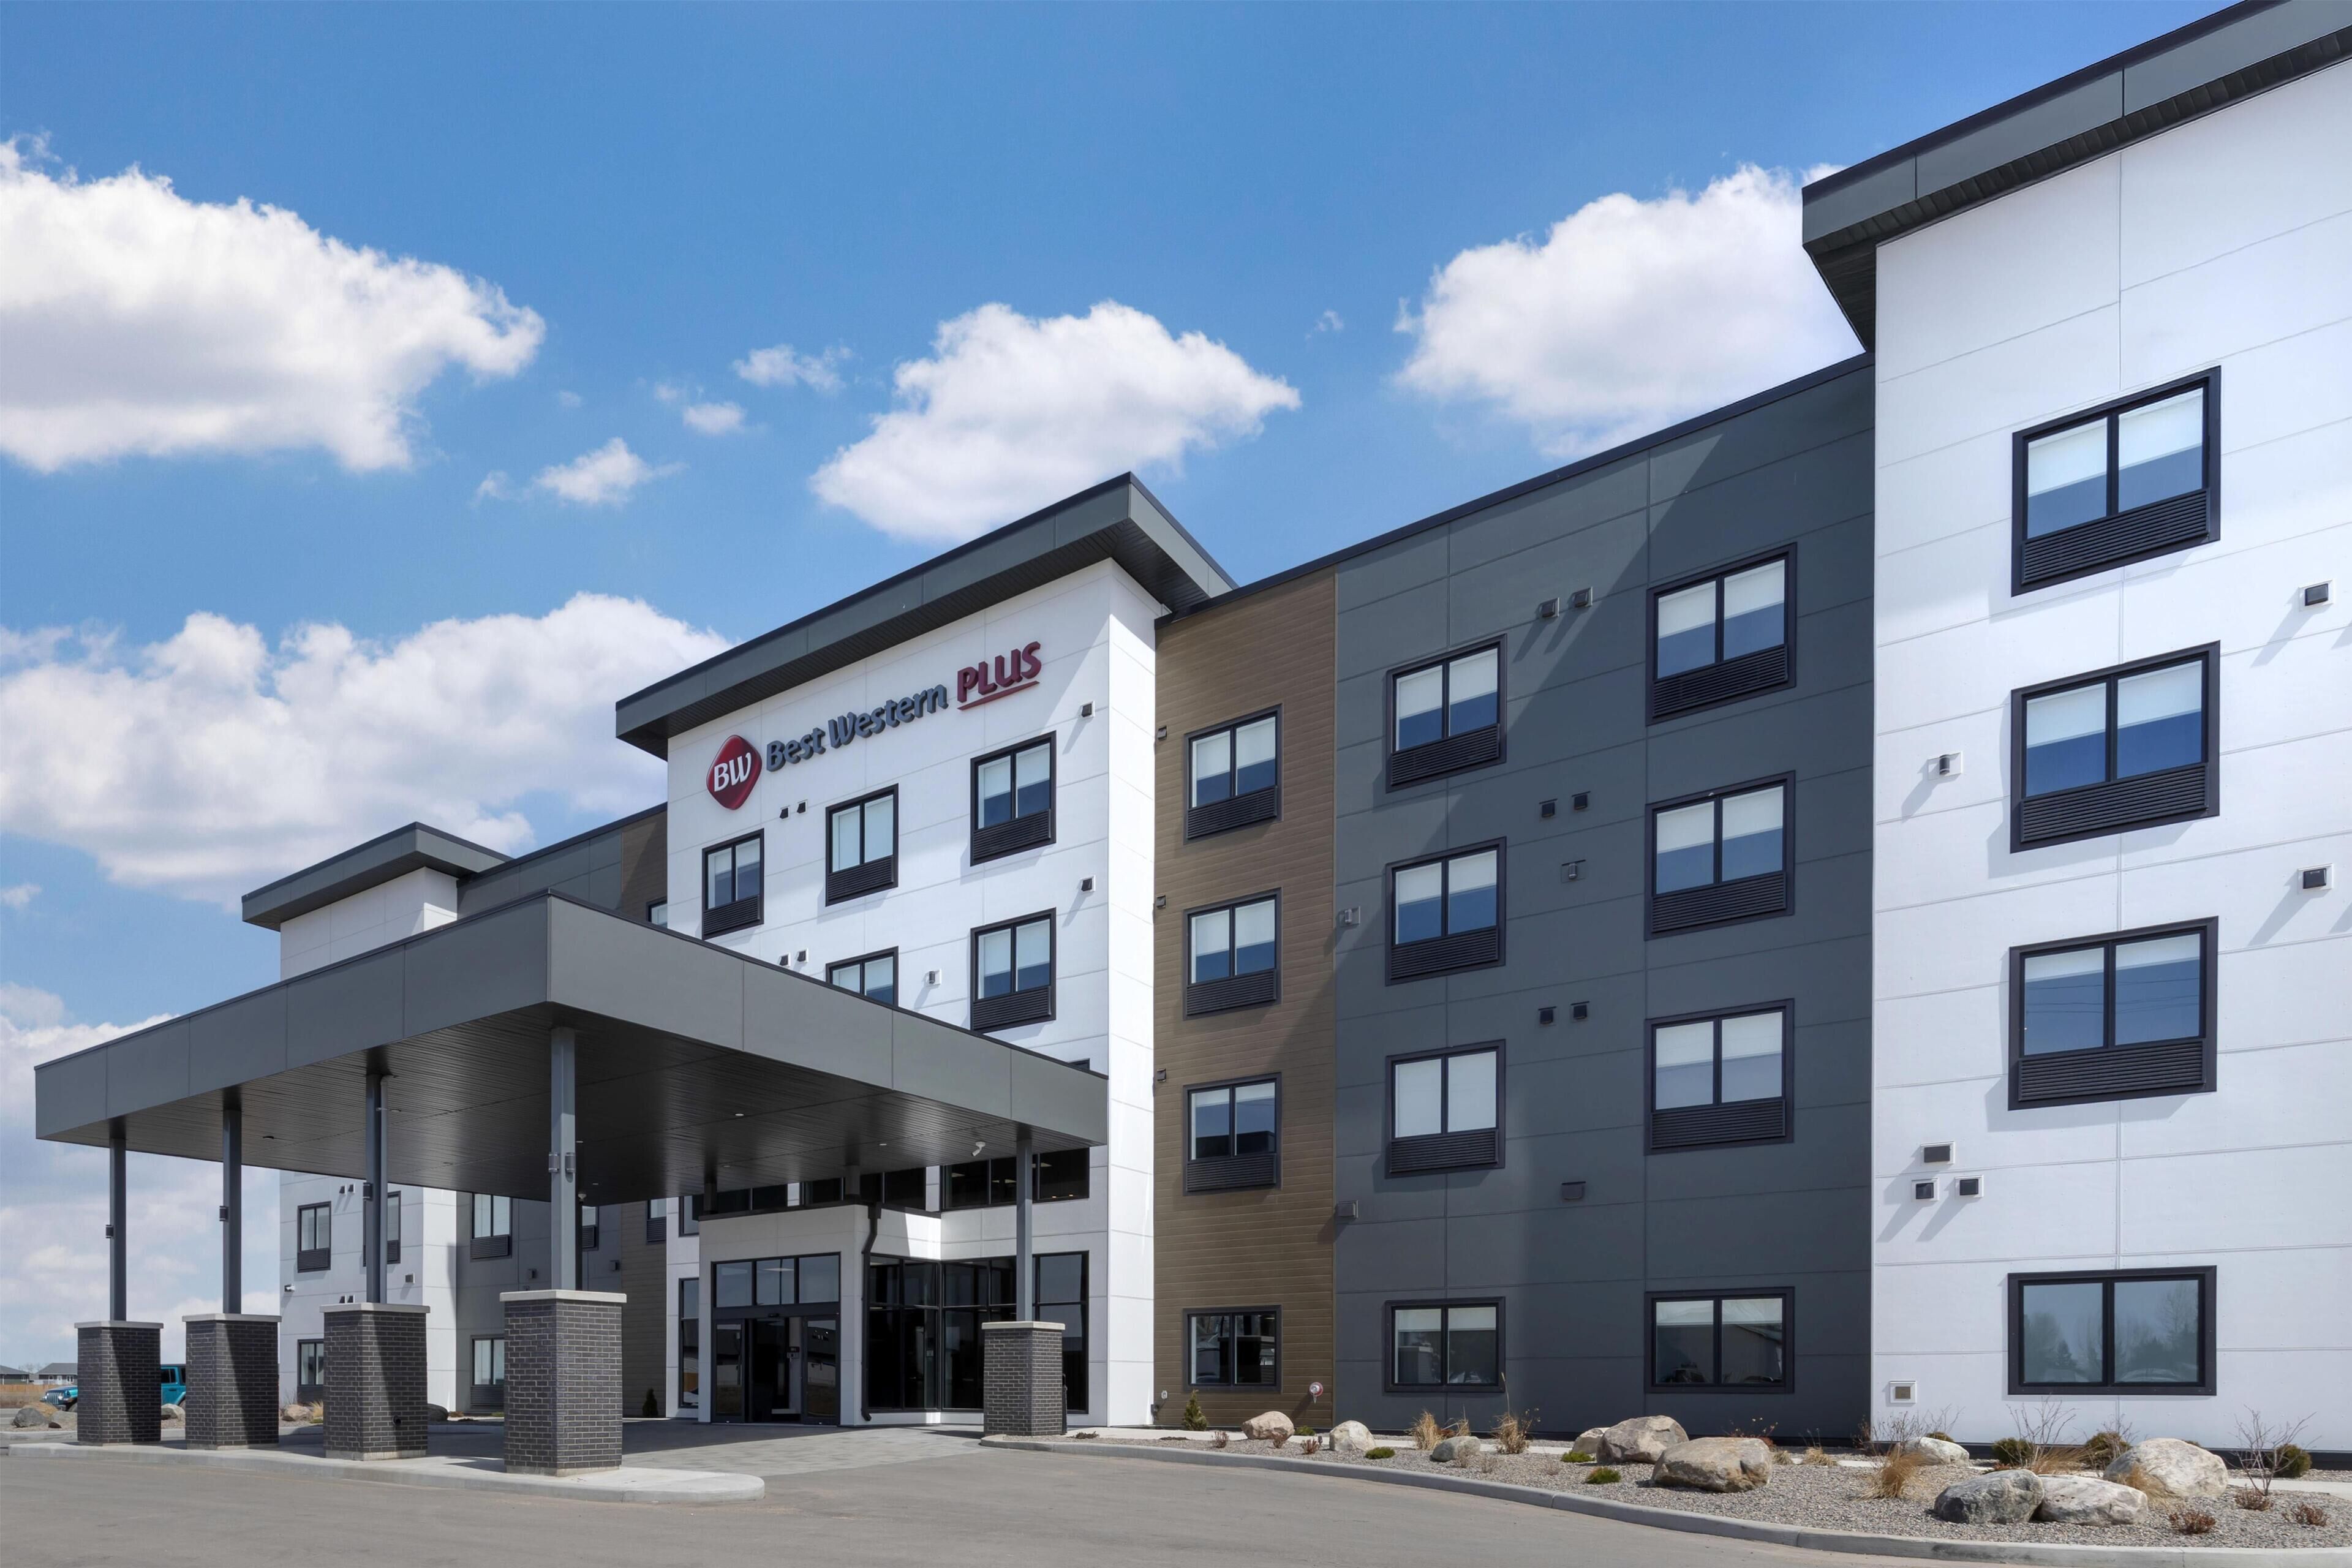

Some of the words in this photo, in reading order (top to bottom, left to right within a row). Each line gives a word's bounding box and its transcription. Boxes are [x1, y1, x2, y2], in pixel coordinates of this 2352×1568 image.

[766, 727, 826, 772] Best
[827, 684, 949, 749] Western
[957, 641, 1042, 703] PLUS
[714, 752, 752, 792] BW
